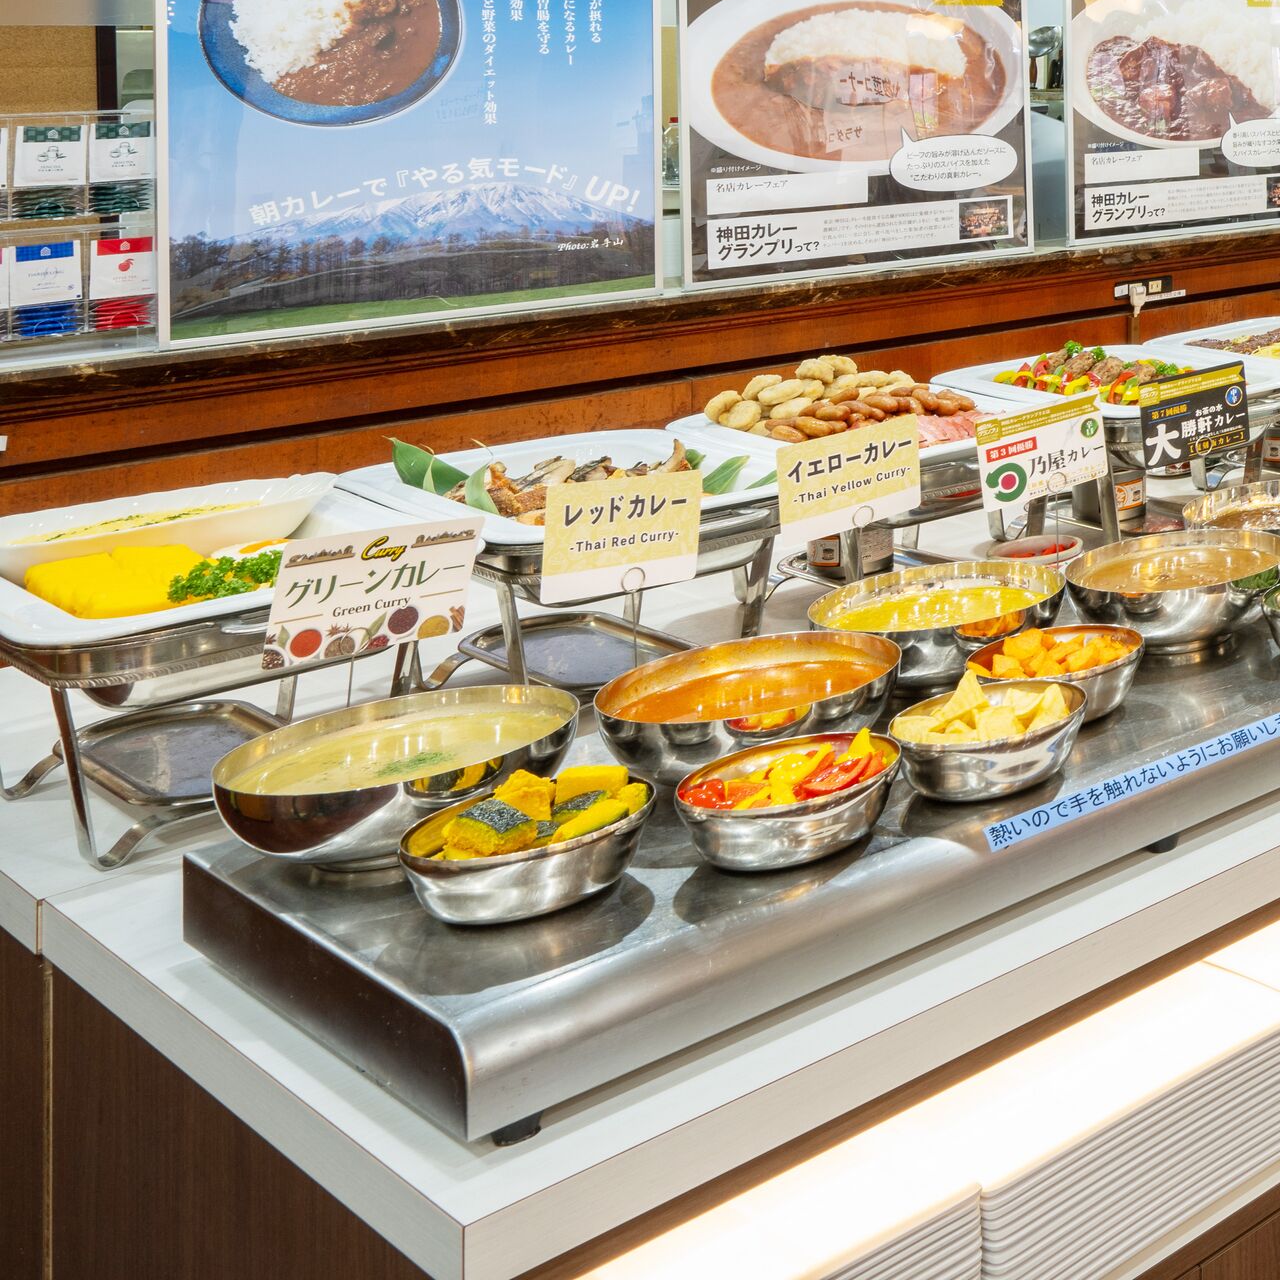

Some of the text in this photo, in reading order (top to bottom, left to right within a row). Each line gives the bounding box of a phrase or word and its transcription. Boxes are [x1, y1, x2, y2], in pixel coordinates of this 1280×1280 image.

[716, 179, 789, 193] 名店カレーフェア
[1091, 191, 1150, 208] 神田カレー
[716, 223, 798, 243] 神田カレー
[1195, 403, 1223, 417] お茶の水
[787, 437, 913, 485] イエローカレー
[830, 477, 873, 496] Yellow
[564, 494, 689, 528] レッドカレー
[361, 535, 408, 562] Curry
[610, 533, 636, 548] Red
[285, 560, 466, 609] グリーンカレー
[332, 595, 412, 619] Green Curry
